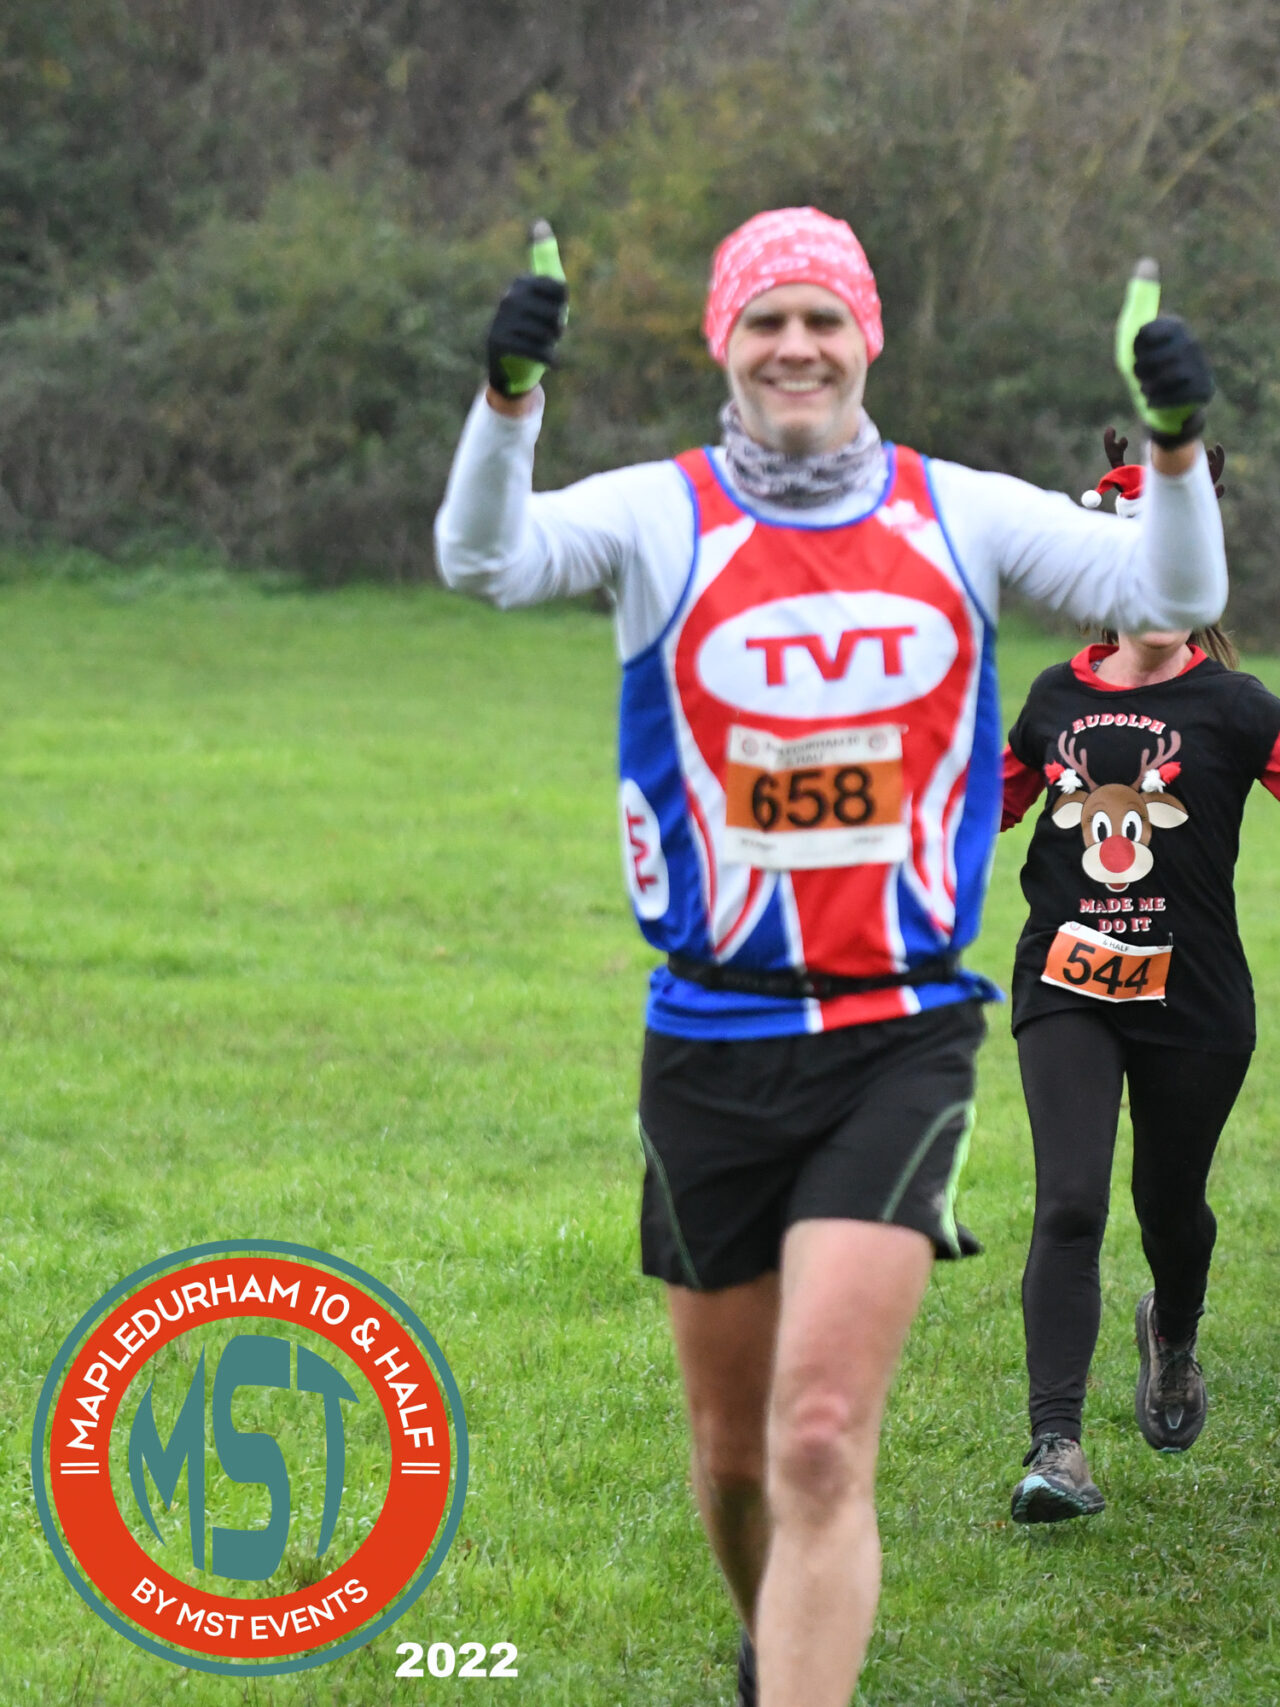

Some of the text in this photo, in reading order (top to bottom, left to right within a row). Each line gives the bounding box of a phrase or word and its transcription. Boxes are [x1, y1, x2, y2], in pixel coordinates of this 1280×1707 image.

[745, 625, 917, 687] TVT
[1072, 713, 1166, 734] RUDOLPH
[752, 765, 874, 832] 658
[626, 805, 659, 894] TVT
[1079, 897, 1166, 913] MADE ME
[1098, 916, 1152, 933] DO IT
[1109, 941, 1130, 952] HALF
[1063, 942, 1152, 995] 544
